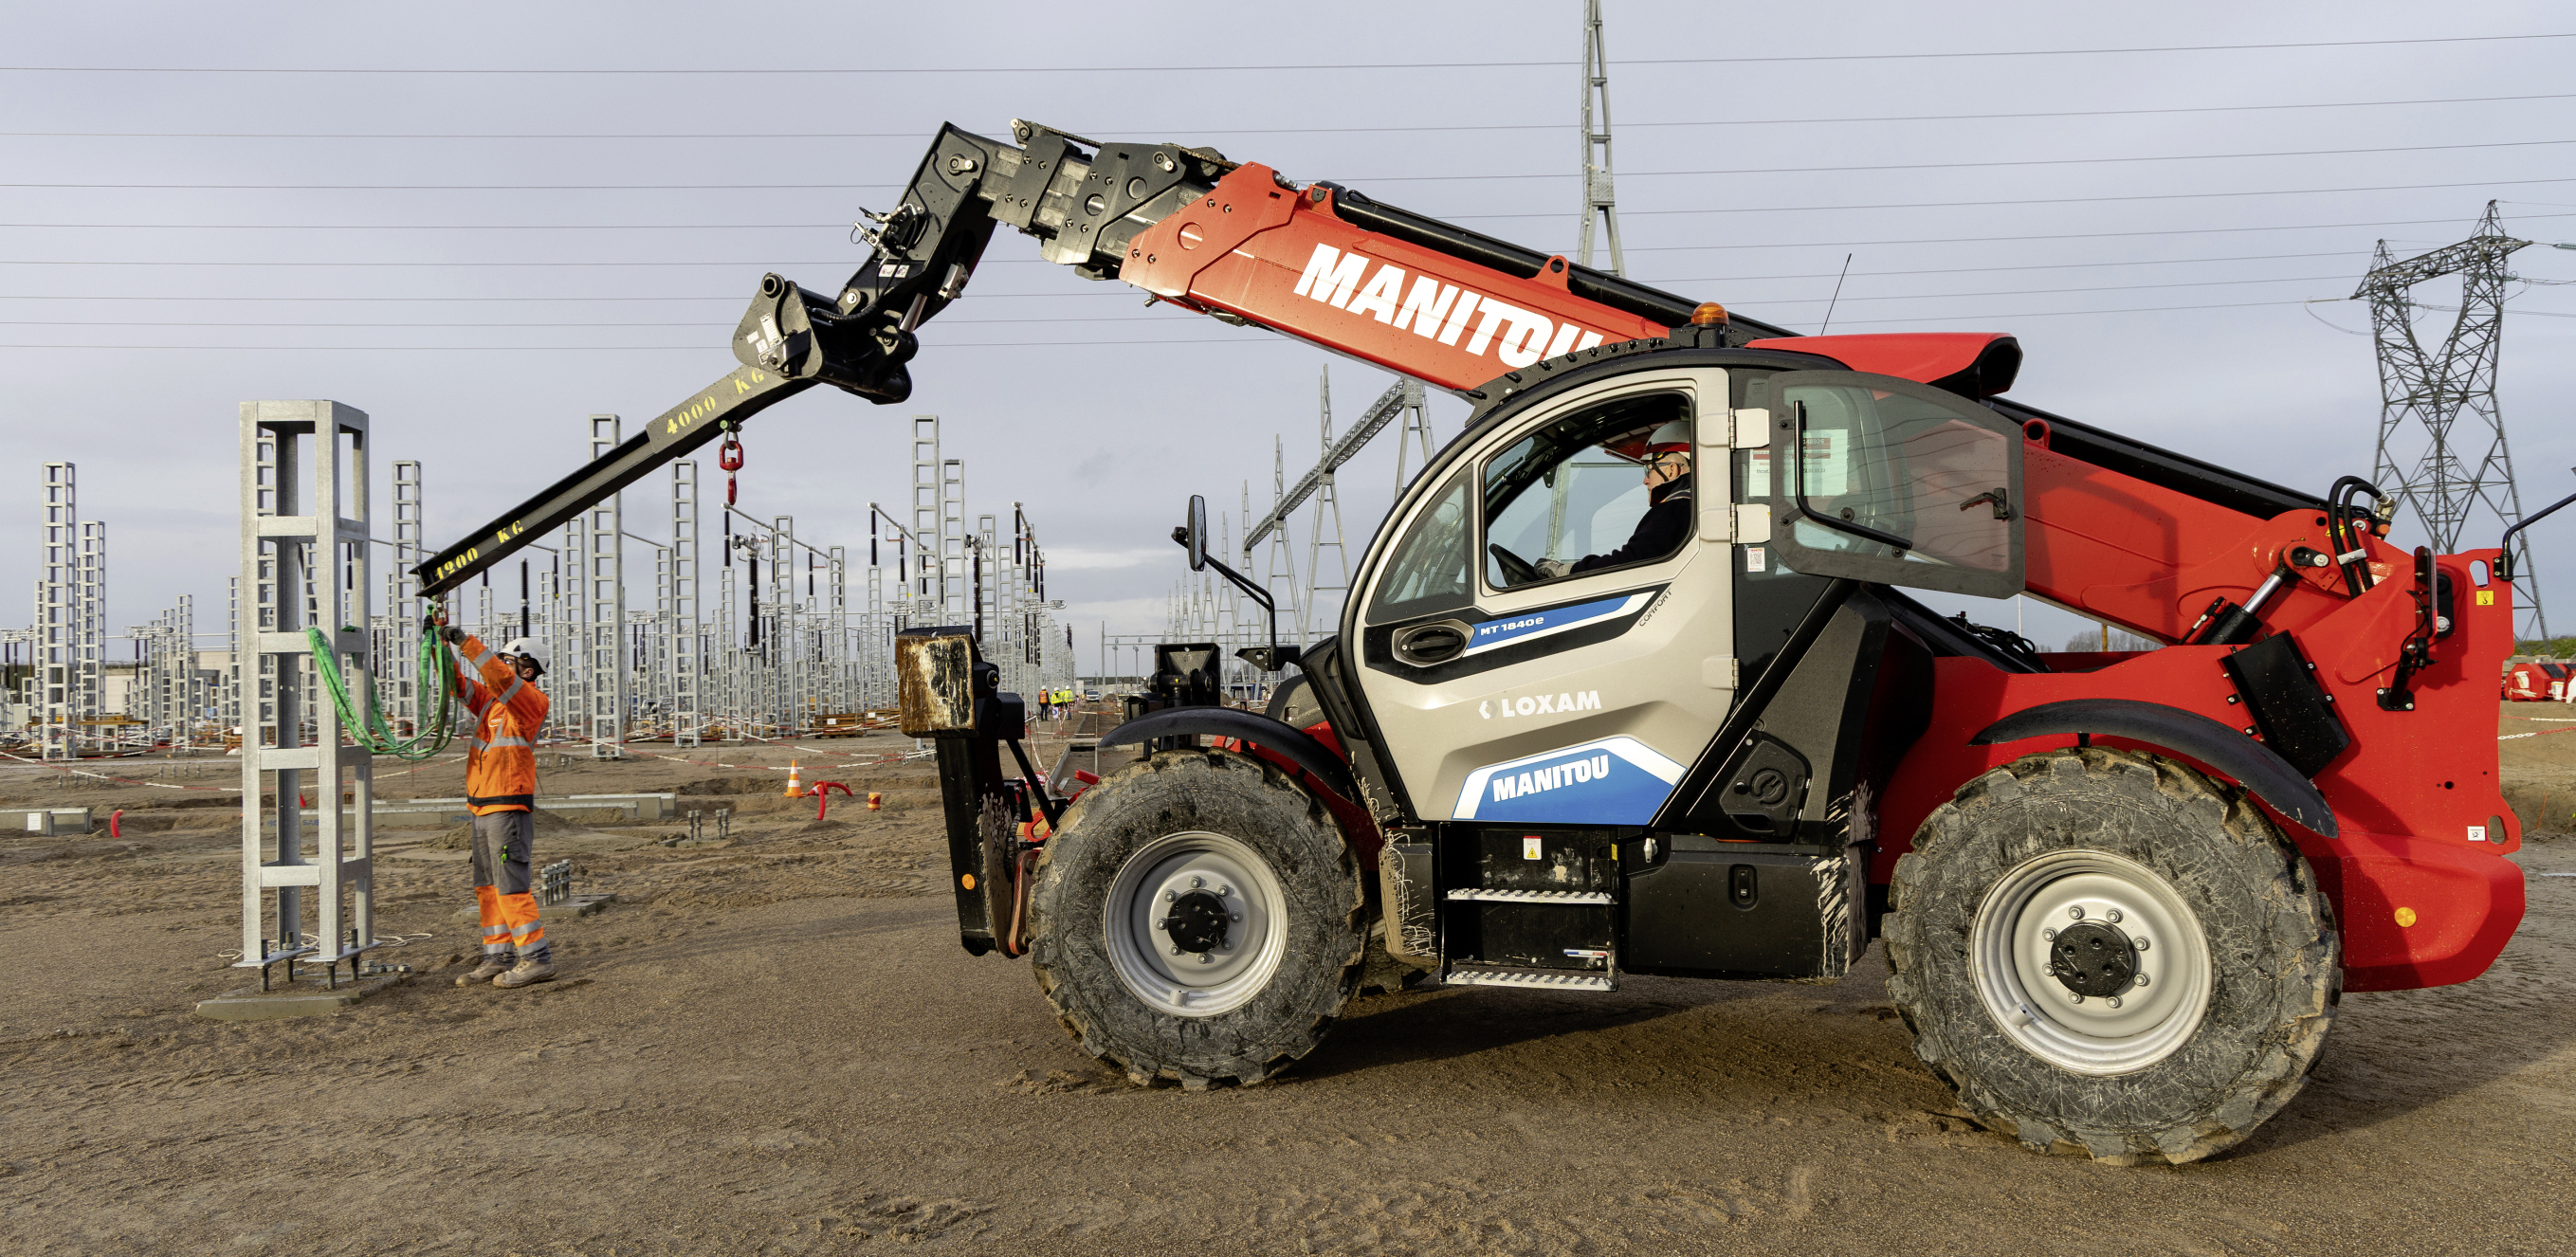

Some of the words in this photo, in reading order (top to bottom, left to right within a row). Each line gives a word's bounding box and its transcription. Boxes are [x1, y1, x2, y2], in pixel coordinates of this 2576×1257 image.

[667, 396, 716, 434] 4000
[734, 368, 764, 394] KG
[435, 547, 479, 580] 1200
[496, 519, 524, 544] KG
[1480, 625, 1499, 636] MT
[1501, 616, 1544, 631] 1840e
[1638, 588, 1672, 628] COMFORT
[1501, 690, 1602, 718] LOXAM
[1492, 754, 1610, 802] MANITOU
